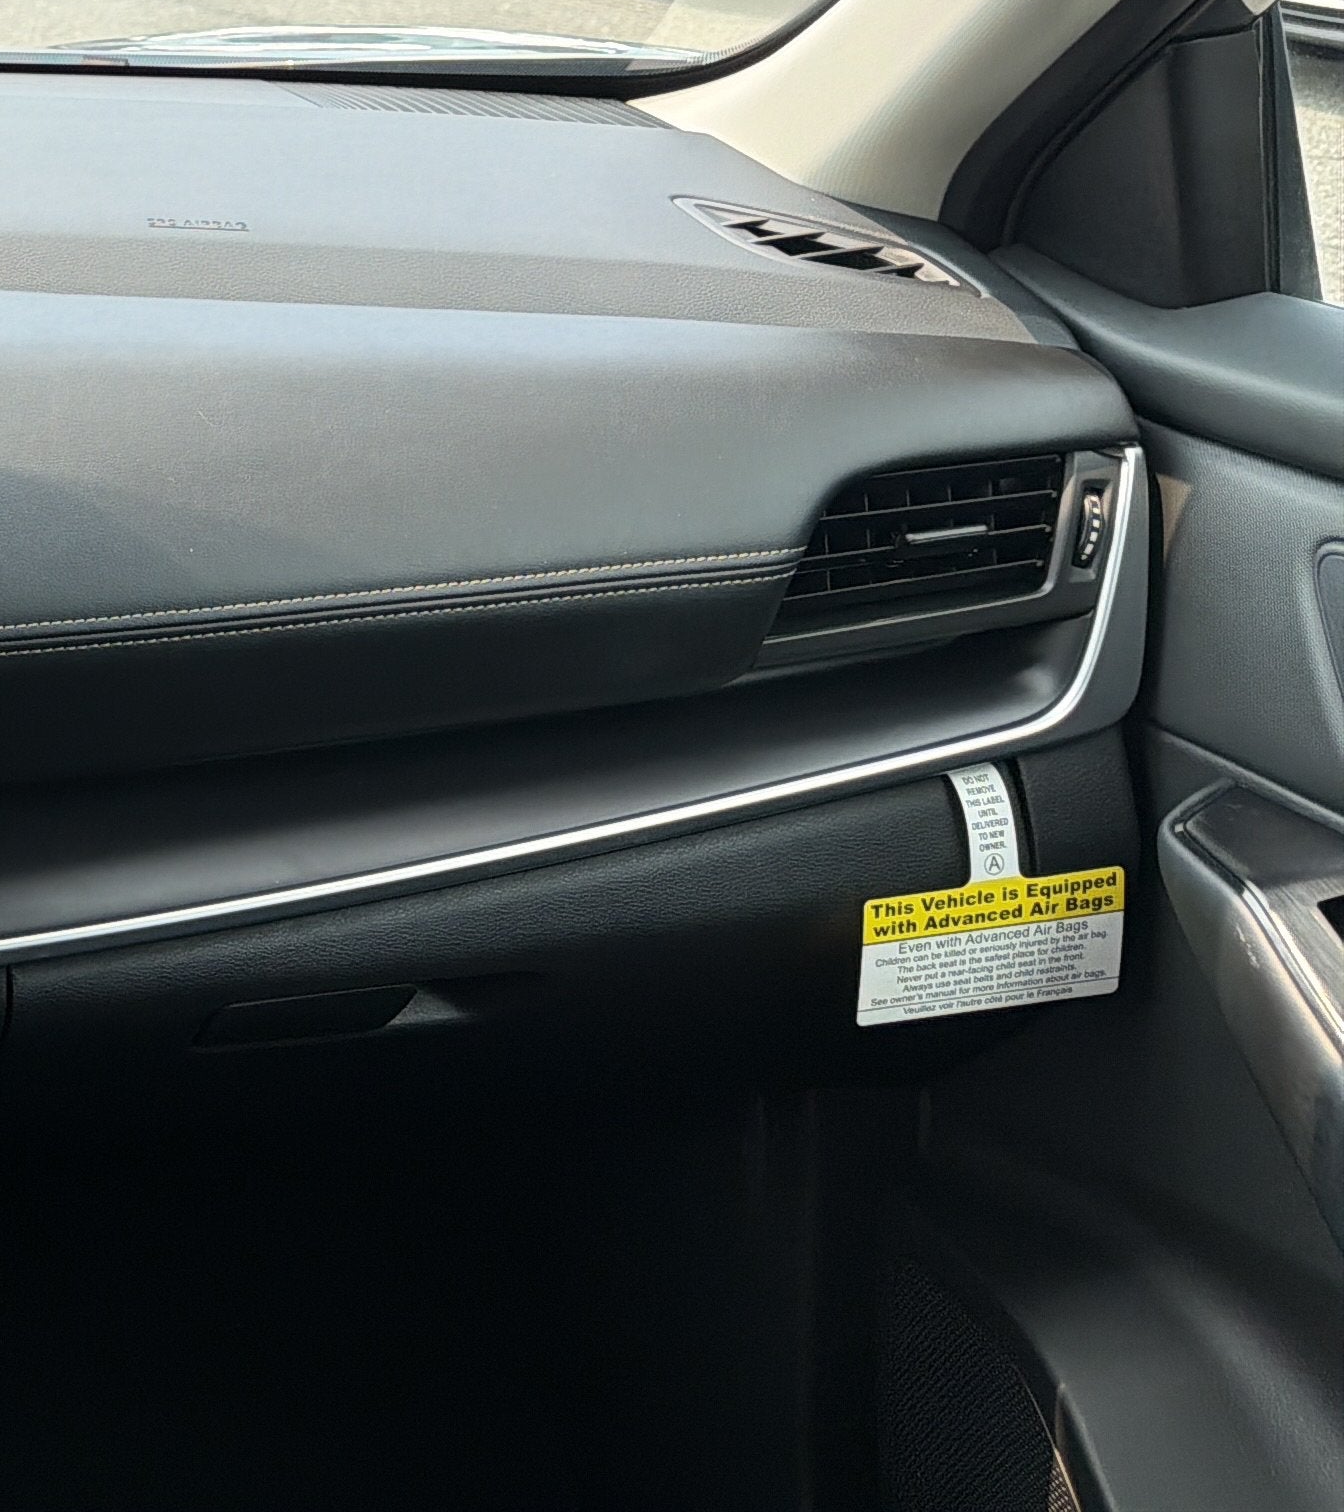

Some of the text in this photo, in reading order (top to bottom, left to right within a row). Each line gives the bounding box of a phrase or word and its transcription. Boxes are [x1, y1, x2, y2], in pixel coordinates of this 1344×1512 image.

[966, 784, 996, 796] REMOVE
[982, 795, 1004, 806] LABEL
[972, 818, 1008, 830] DELIVERED
[978, 808, 998, 818] UNTIL
[870, 872, 1117, 919] This Vehicle is Equipped
[872, 894, 1114, 938] with Advanced Air Bags
[875, 934, 1076, 968] Children can killed seriously injured the
[898, 920, 1089, 954] Even with Advanced Air Bags
[896, 954, 1062, 984] Never put rear-facing child seat the
[897, 946, 1049, 974] The back seat the safest place for
[870, 974, 1070, 1006] See manual more information about
[902, 968, 1034, 994] Always use seat belts and child
[902, 986, 1073, 1015] Veuillez voir pour Français
